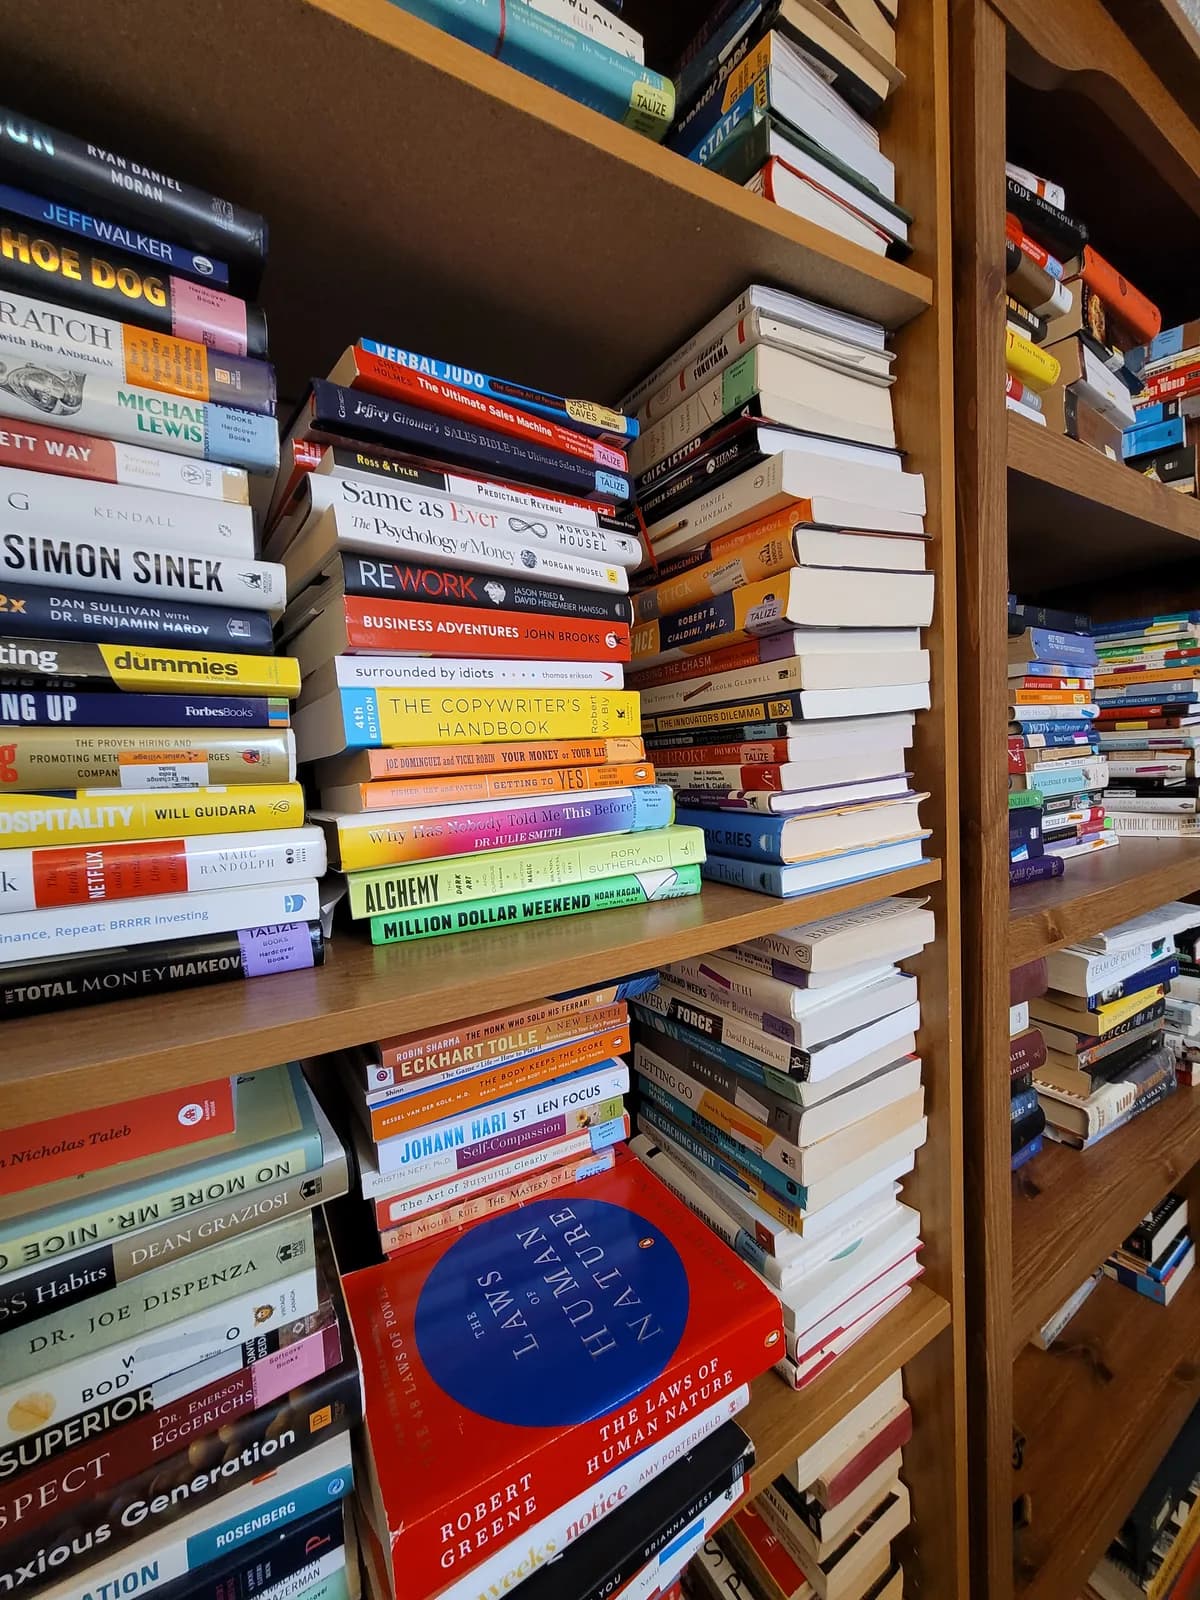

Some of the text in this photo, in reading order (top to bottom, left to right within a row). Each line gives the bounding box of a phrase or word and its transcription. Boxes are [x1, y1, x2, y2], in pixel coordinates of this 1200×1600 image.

[637, 94, 667, 117] TALIZE
[87, 144, 183, 193] RYAN DANIEL
[110, 169, 163, 202] MORAN
[1007, 180, 1031, 202] CODE
[90, 257, 166, 308] DOG
[375, 343, 485, 389] VERBAL JUDO
[693, 346, 728, 381] FUKUYAMA
[417, 376, 553, 437] The Ultimate Sales Machine
[137, 413, 202, 442] LEWIS
[44, 441, 92, 462] WAY
[715, 444, 739, 464] TITANS
[342, 480, 498, 530] Same as Ever
[693, 501, 733, 528] KAHNEMAN
[700, 491, 726, 513] DANIEL
[93, 506, 176, 528] KENDALL
[352, 515, 515, 562] The Psychology of Money
[3, 533, 223, 593] SIMON SINEK
[542, 558, 604, 578] MORGAN HOUSEL
[512, 587, 565, 601] JASON FRIED &
[514, 595, 608, 616] DAVID HEINEMEIER HANSSON
[50, 597, 161, 618] DAN SULLIVAN
[678, 607, 718, 627] ROBERT B.
[750, 607, 778, 622] TALIZE
[50, 610, 210, 636] DR. BENJAMIN HARDY
[362, 615, 600, 643] BUSINESS ADVENTURES JOHN BROOKS
[114, 651, 240, 677] dummies
[355, 665, 593, 681] surrounded by idiots thomas erikson
[681, 656, 711, 674] CHASM
[46, 695, 78, 721] UP
[355, 707, 364, 729] 4th
[368, 696, 378, 739] EDITION
[389, 698, 581, 714] THE COPYWRITER'S
[660, 708, 761, 728] THE DILEMMA
[438, 720, 549, 737] HANDBOOK
[76, 739, 192, 748] THE PROVEN HIRING AND
[29, 754, 90, 764] PROMOTING
[385, 748, 591, 770] JOE DOMINGUEZ and VICKI ROBIN YOUR MONEY or YOUR
[743, 752, 769, 762] TALIZE
[493, 778, 538, 790] GETTING
[541, 777, 554, 787] TO
[558, 768, 584, 790] YES
[155, 804, 256, 820] WILL GUIDARA
[1114, 817, 1149, 833] CATHOLIC
[474, 827, 563, 849] DR JULIE SMITH
[725, 833, 752, 848] RIES
[200, 857, 275, 875] RANDOLPH
[218, 849, 257, 861] MARC
[588, 854, 664, 874] SUTHERLAND
[610, 847, 641, 859] RORY
[85, 851, 106, 899] NETFLIX
[365, 873, 440, 914] ALCHEMY
[55, 910, 209, 938] Repeat: BRRRR Investing
[687, 979, 708, 998] WEEKS
[710, 991, 730, 1008] Oliver
[396, 998, 591, 1062] ROBIN SHARMA THE MONK WHO SOLD HIS FERRARI
[677, 1008, 713, 1034] FORCE
[400, 1007, 621, 1078] ECKHART TOLLE A NEW EARTH
[725, 1028, 741, 1042] David
[479, 1040, 604, 1088] THE BODY KEEPS THE SCORE
[692, 1060, 730, 1089] SUSAN CAIN
[639, 1055, 693, 1100] LETTING GO
[401, 1084, 601, 1164] JOHANN HARI FOCUS
[10, 1125, 132, 1167] Nicholas Taleb
[462, 1120, 561, 1161] Self-Compassion
[645, 1107, 716, 1168] THE COACHING HABIT
[400, 1152, 549, 1213] The Art of Clearly
[131, 1191, 289, 1266] DEAN GRAZIOSI
[36, 1265, 107, 1304] Habits
[29, 1259, 258, 1355] DR. JOE DISPENZA
[476, 1269, 541, 1361] LAWS
[600, 1357, 720, 1443] THE LAWS OF
[586, 1369, 734, 1476] HUMAN NATURE
[638, 1415, 721, 1483] AMY PORTERFIELD
[120, 1428, 296, 1529] Generation
[440, 1472, 534, 1544] ROBERT
[216, 1501, 297, 1548] ROSENBERG
[440, 1497, 538, 1570] GREENE
[644, 1490, 713, 1559] BRIANNA WIEST
